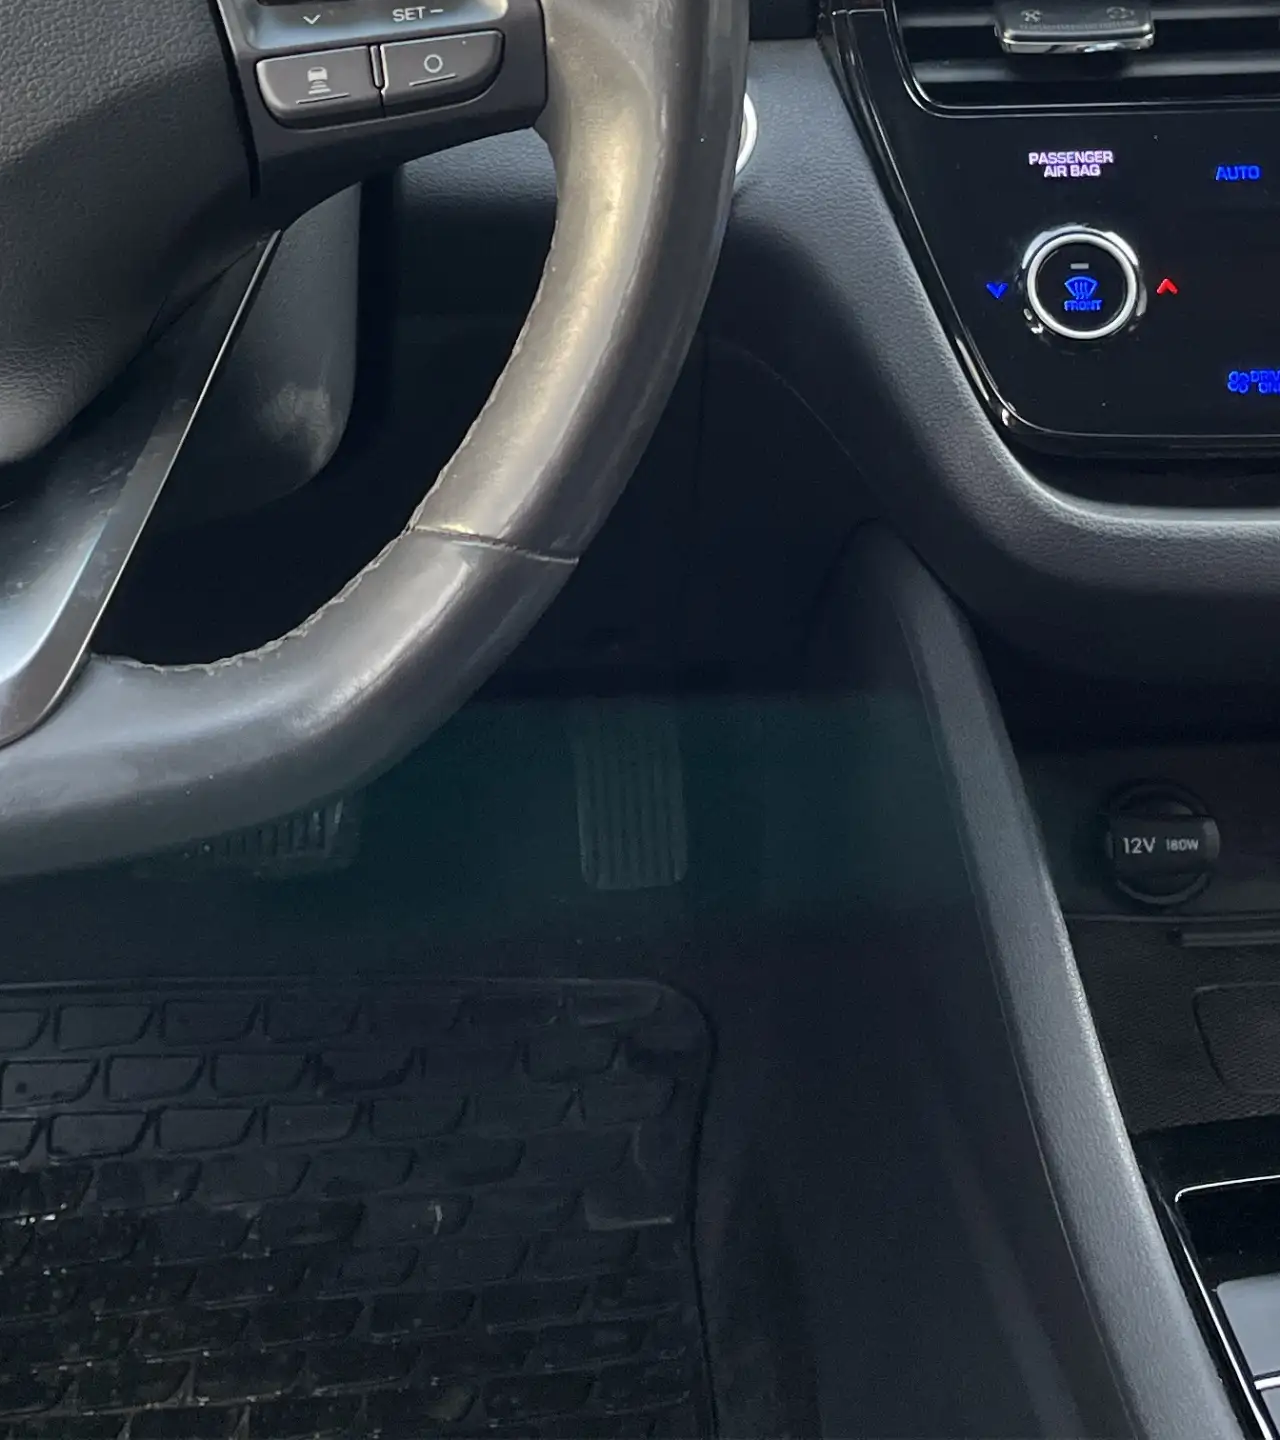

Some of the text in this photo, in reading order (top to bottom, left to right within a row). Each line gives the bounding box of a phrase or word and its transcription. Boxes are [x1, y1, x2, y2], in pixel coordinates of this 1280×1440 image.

[392, 7, 425, 22] SET
[1028, 149, 1114, 165] PASSENGER
[1043, 163, 1101, 178] AIR BAG
[1215, 165, 1261, 181] AUTO
[1064, 299, 1102, 312] FRONT
[1122, 837, 1156, 855] 12V
